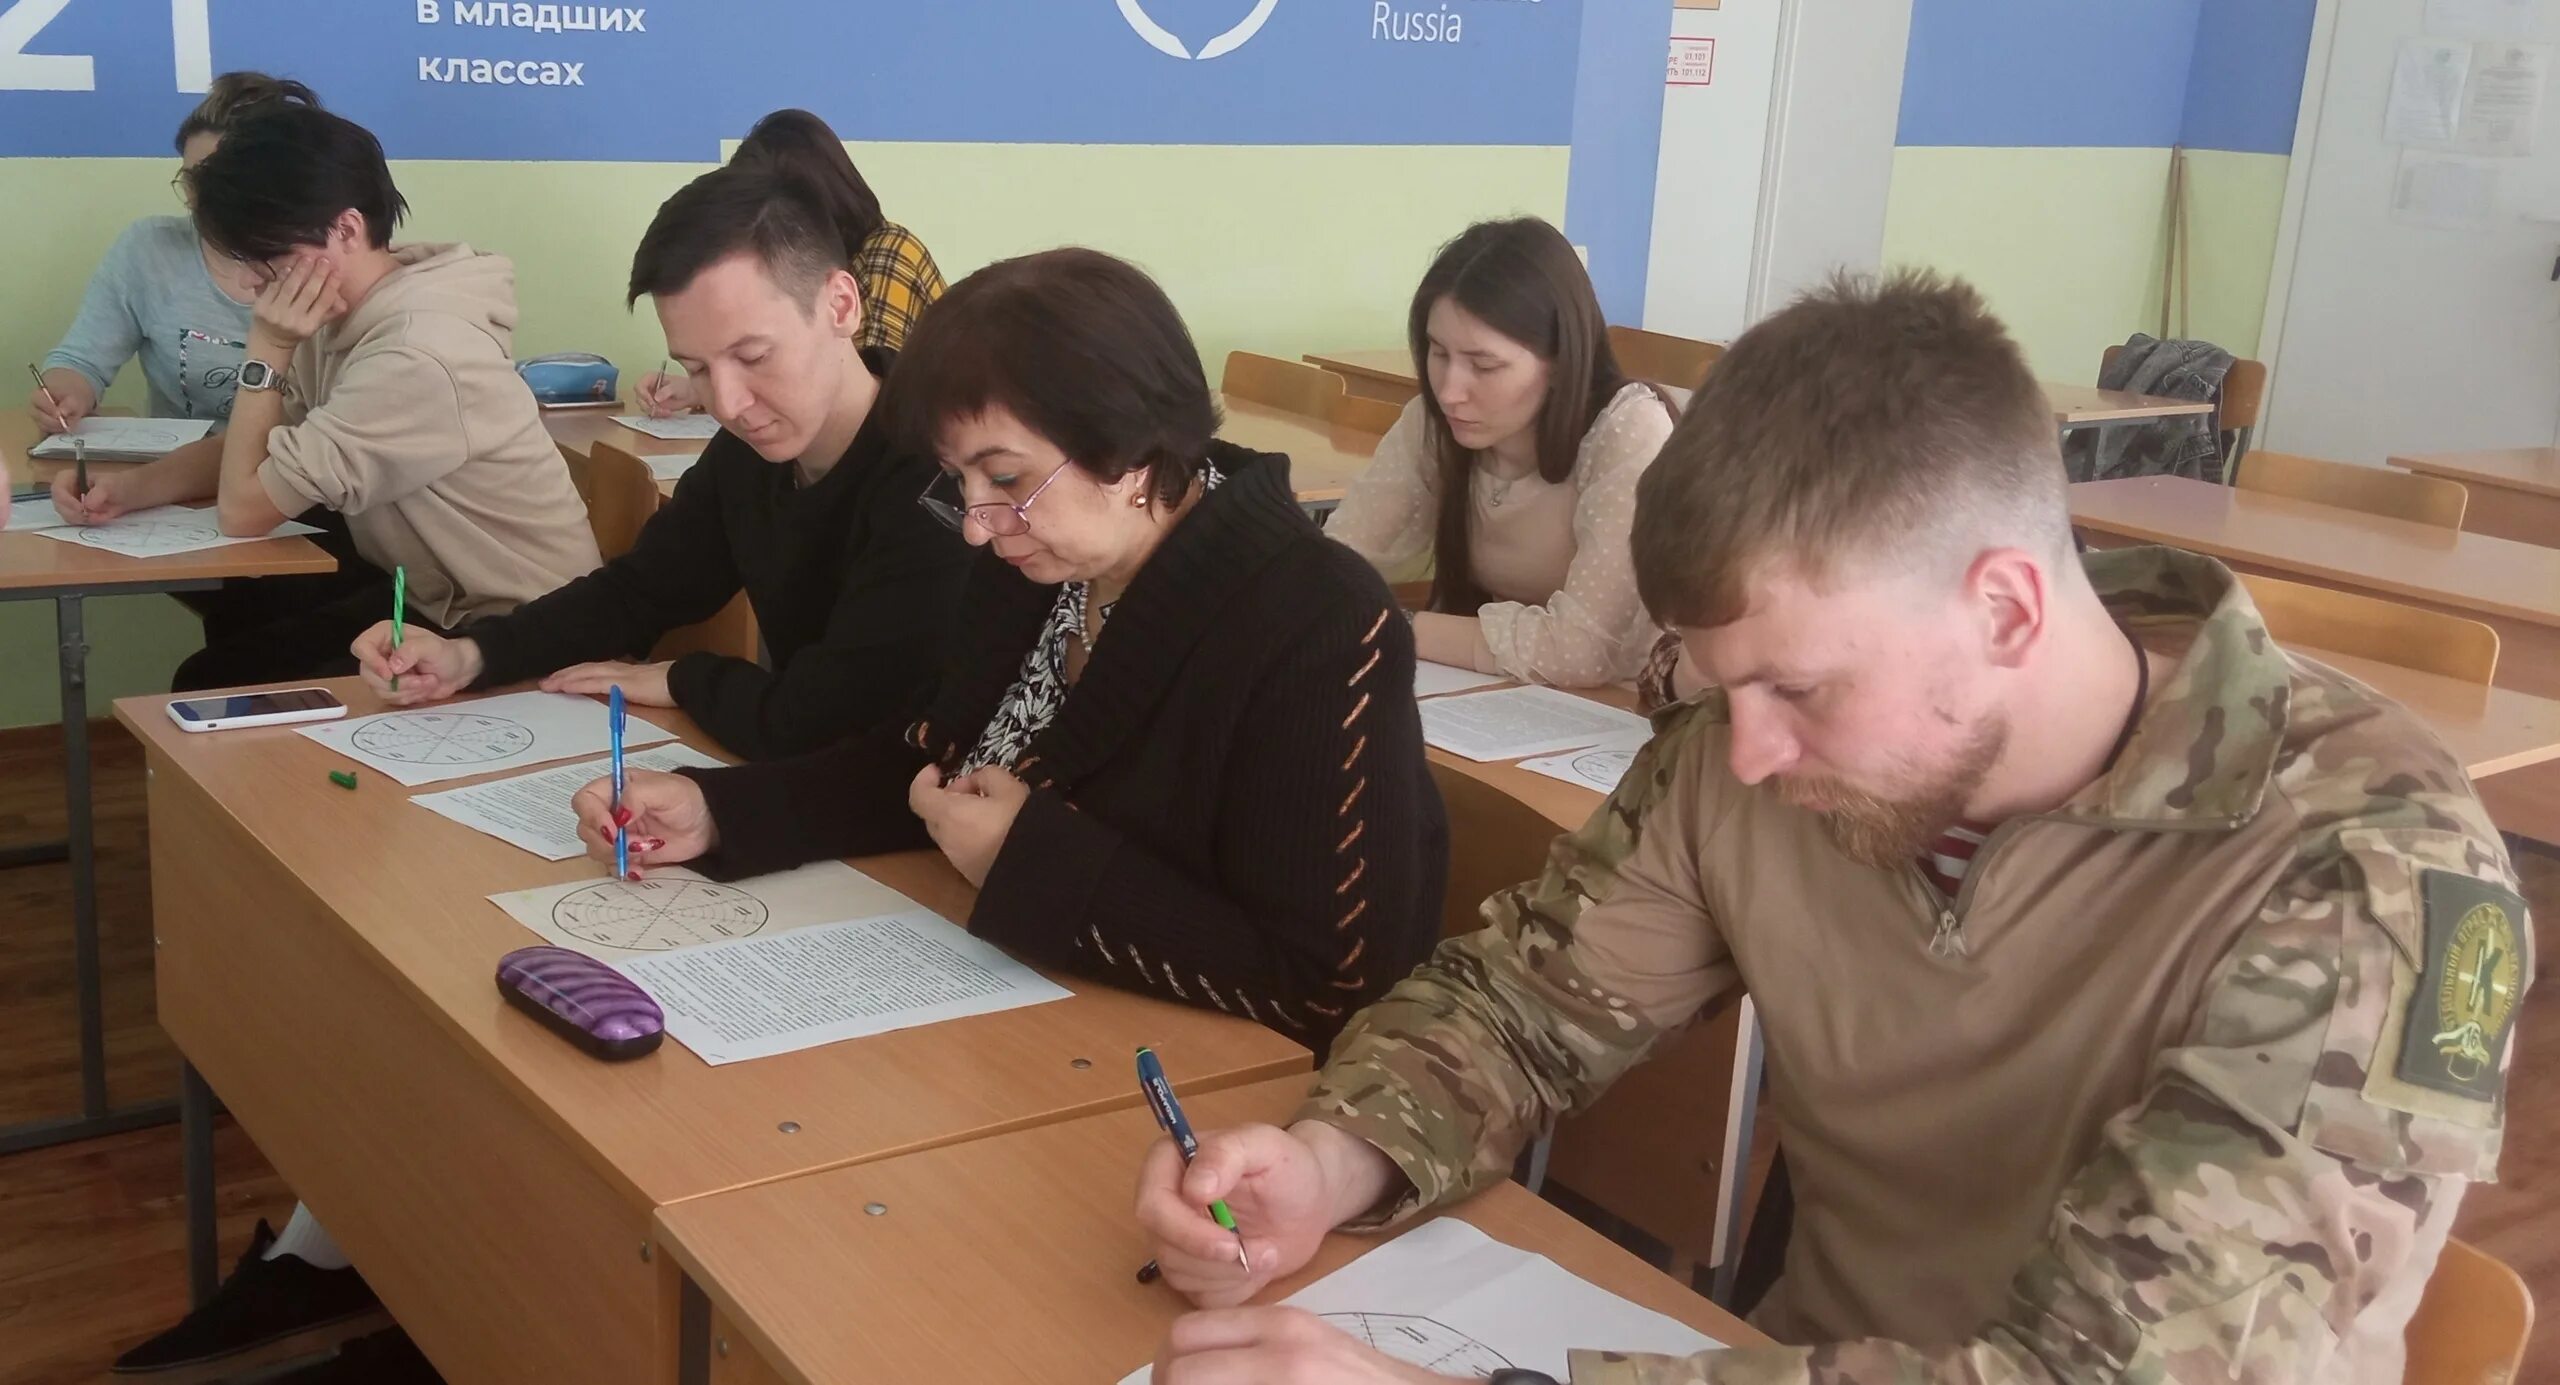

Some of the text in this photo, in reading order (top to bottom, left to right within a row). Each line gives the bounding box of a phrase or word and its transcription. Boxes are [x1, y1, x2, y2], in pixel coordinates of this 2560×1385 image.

[417, 0, 647, 33] в младших
[1372, 1, 1461, 42] Russia
[418, 56, 585, 86] классах
